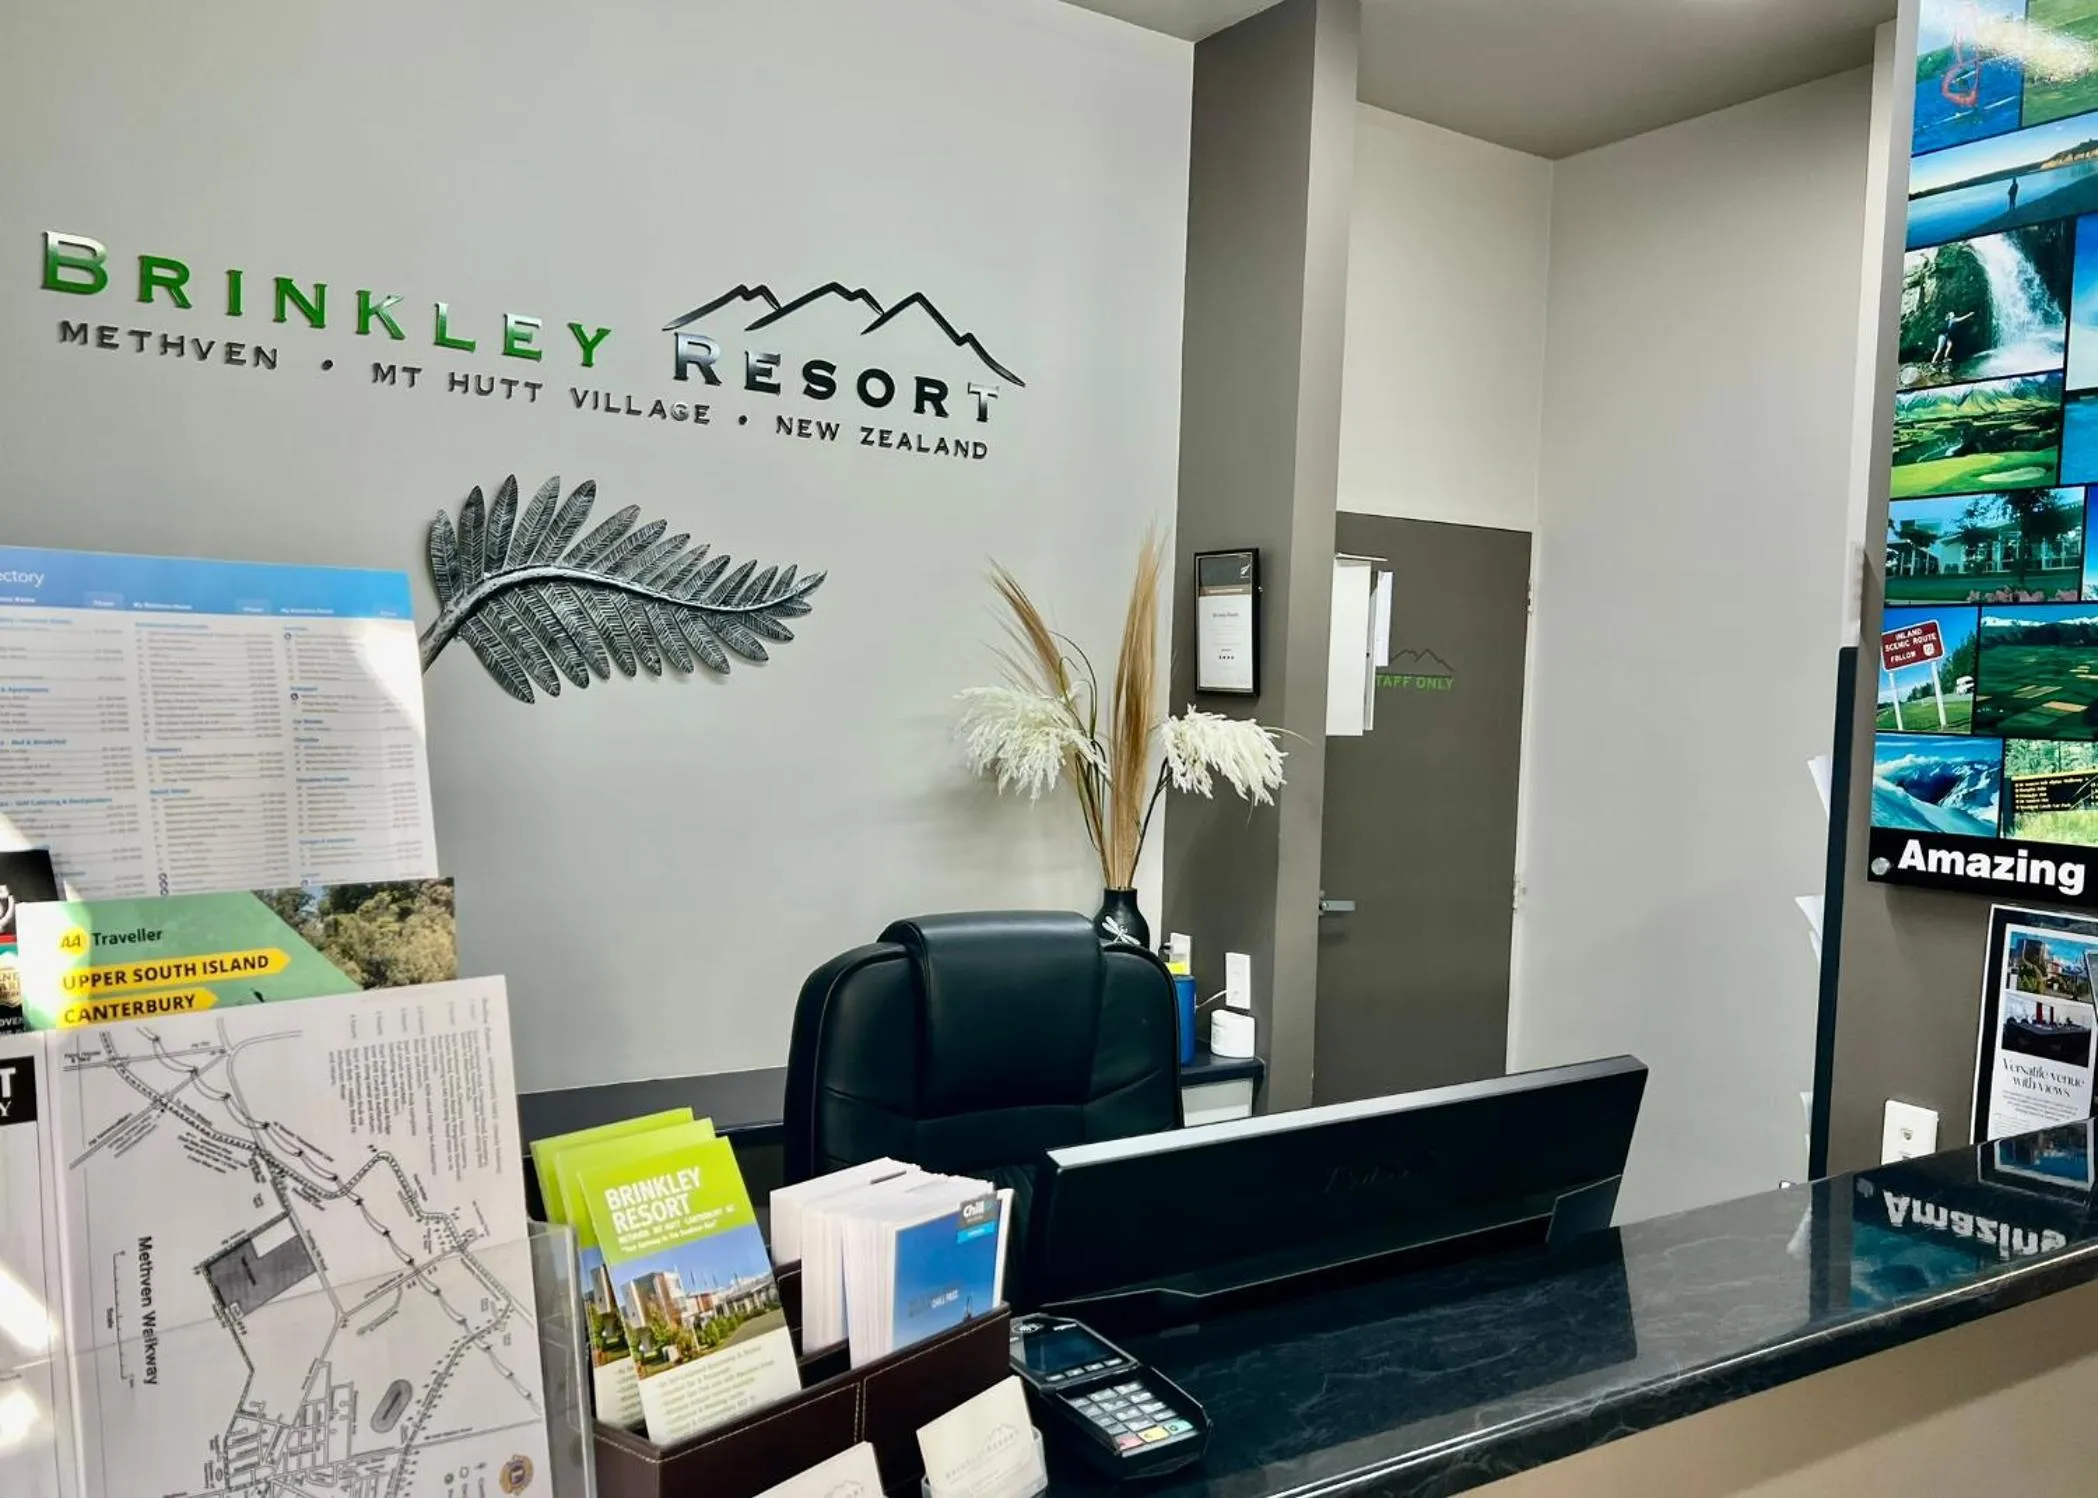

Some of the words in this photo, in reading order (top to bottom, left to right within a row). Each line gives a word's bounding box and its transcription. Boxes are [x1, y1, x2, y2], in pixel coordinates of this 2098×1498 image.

[40, 230, 611, 367] BRINKLEY
[673, 332, 999, 423] RESORT
[58, 319, 278, 370] METHVEN
[371, 361, 423, 388] MT
[447, 371, 544, 403] HUTT
[570, 388, 710, 425] VILLAGE
[776, 415, 840, 441] NEW
[860, 426, 988, 460] ZEALAND
[1885, 640, 1910, 652] SCENIC
[1913, 633, 1936, 645] ROUTE
[1895, 628, 1922, 640] INLAND
[1890, 651, 1916, 663] FOLLOW
[1376, 675, 1411, 688] TAFF
[1416, 677, 1455, 690] ONLY
[1898, 839, 2085, 896] Amazing
[92, 928, 162, 946] Traveller
[62, 971, 128, 991] UPPER
[133, 963, 197, 983] SOUTH
[202, 955, 269, 974] ISLAND
[64, 994, 197, 1024] CANTERBURY
[2003, 1058, 2048, 1079] Versatile
[2051, 1072, 2084, 1087] venue
[2013, 1076, 2036, 1090] with
[2039, 1083, 2071, 1097] views
[604, 1165, 700, 1211] BRINKLEY
[612, 1192, 691, 1235] RESORT
[137, 1236, 154, 1308] Methven
[142, 1310, 159, 1385] Walkway
